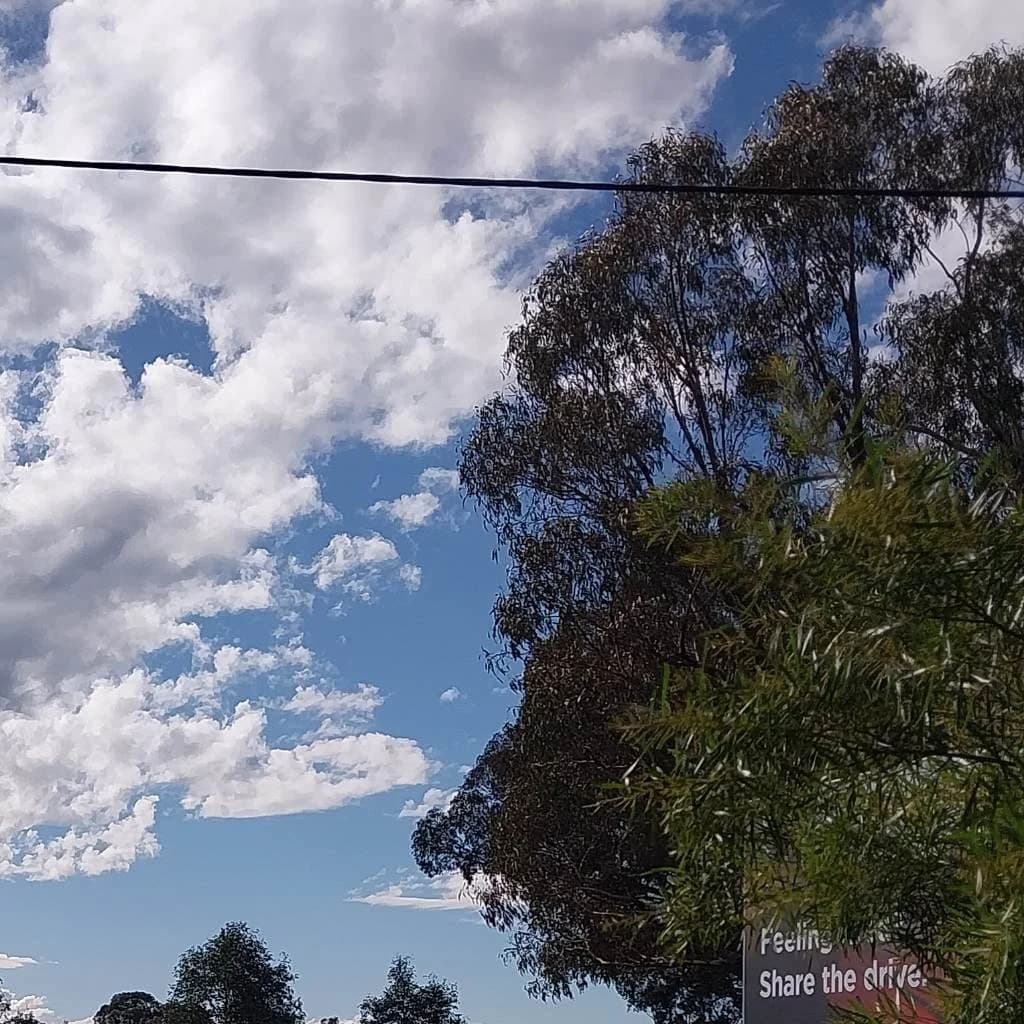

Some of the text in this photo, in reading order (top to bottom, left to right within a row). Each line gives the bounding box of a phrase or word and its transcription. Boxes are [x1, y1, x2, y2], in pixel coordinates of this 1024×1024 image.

[759, 958, 928, 999] Share the drive.
